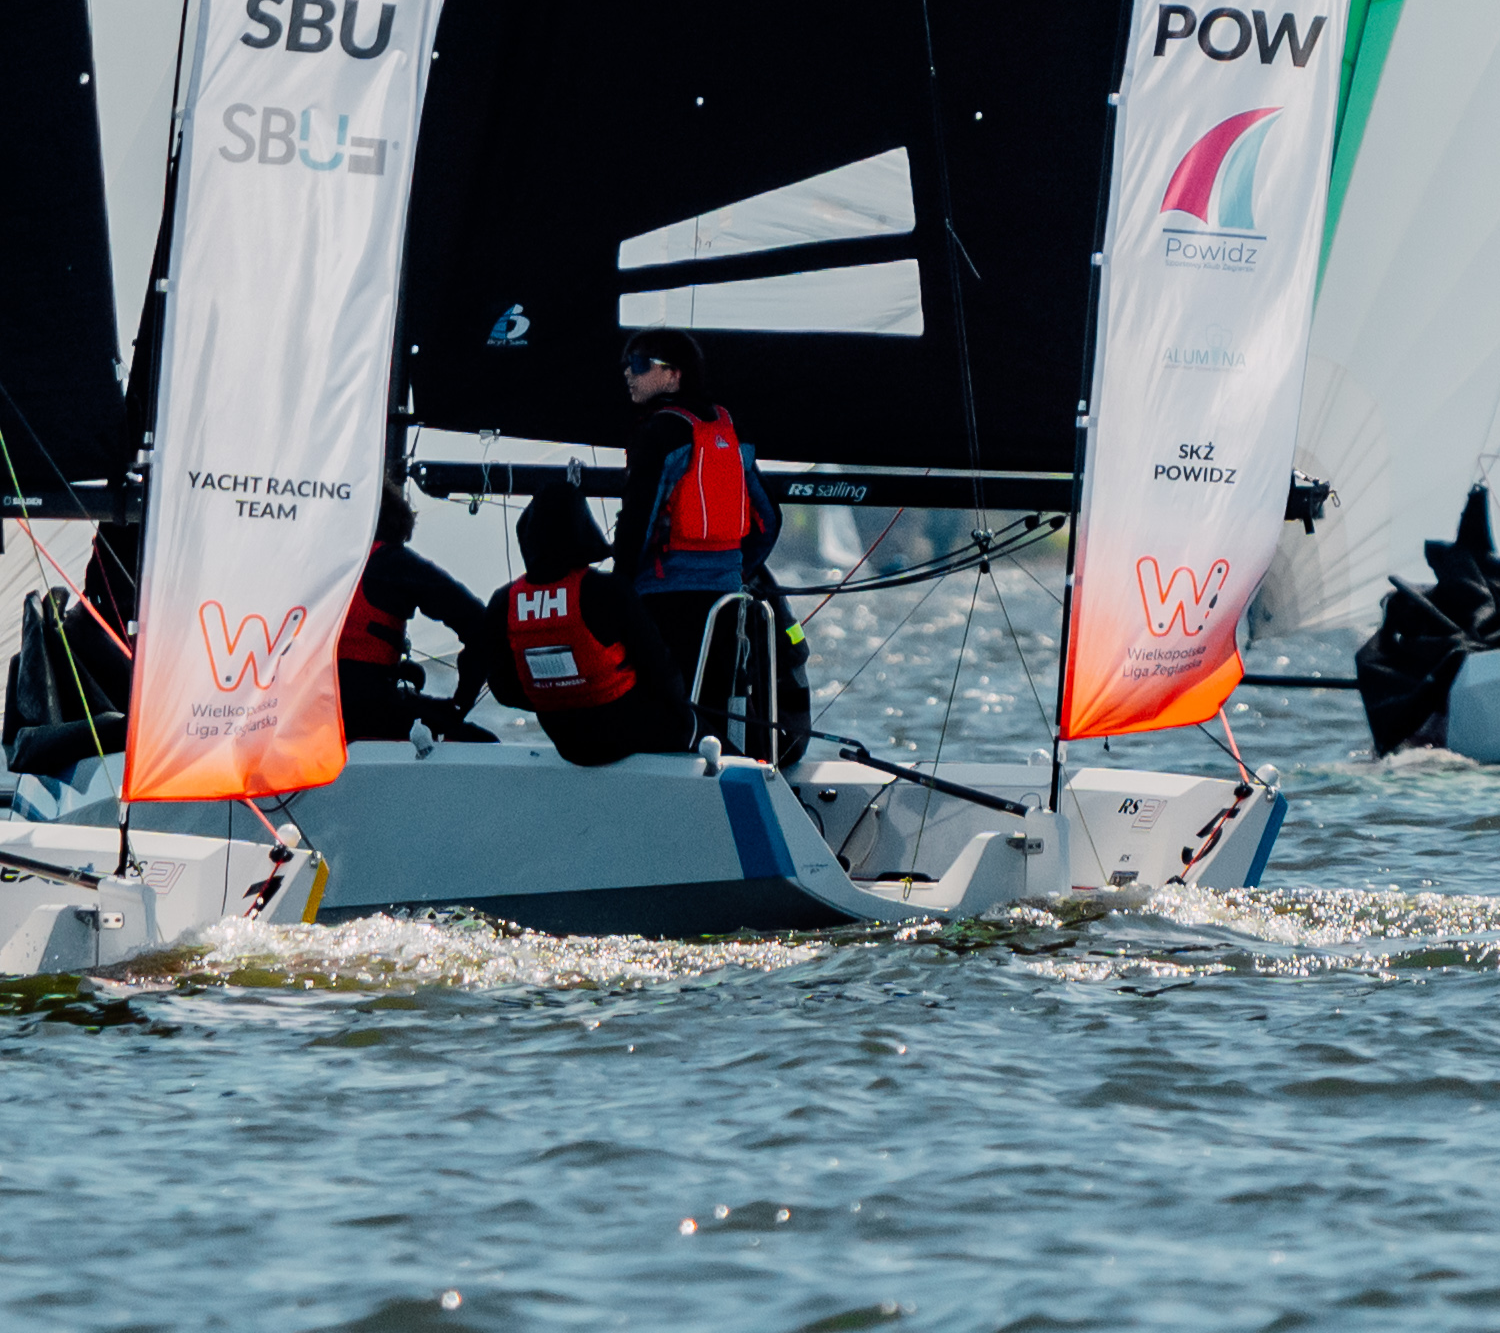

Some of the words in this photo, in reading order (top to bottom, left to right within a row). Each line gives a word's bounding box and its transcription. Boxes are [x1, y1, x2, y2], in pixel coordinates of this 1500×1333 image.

[1153, 3, 1328, 68] POW
[1165, 237, 1257, 264] Powidz
[1178, 441, 1215, 461] SKŻ
[1154, 464, 1237, 484] POWIDZ
[188, 471, 270, 493] YACHT
[266, 478, 351, 500] RACING
[788, 483, 814, 496] RS
[816, 481, 867, 502] sailing
[235, 500, 297, 521] TEAM
[517, 587, 567, 621] HH
[1123, 664, 1149, 680] Liga
[186, 722, 219, 740] Liga
[1118, 798, 1142, 815] RS
